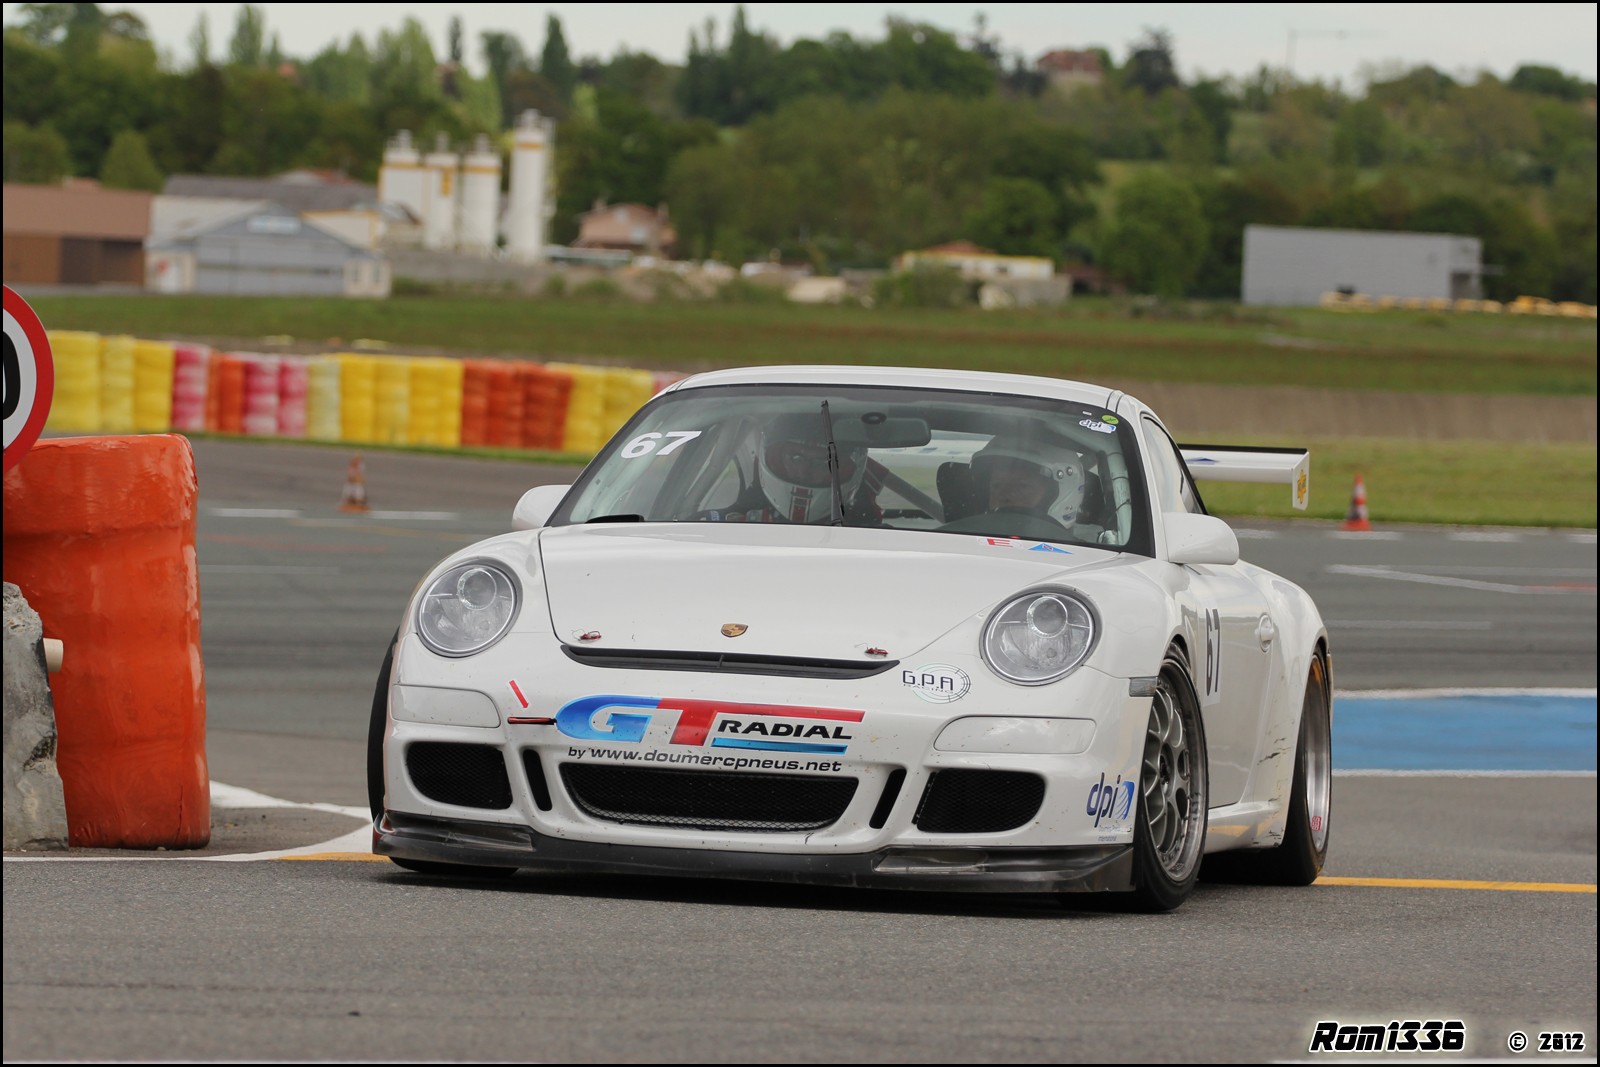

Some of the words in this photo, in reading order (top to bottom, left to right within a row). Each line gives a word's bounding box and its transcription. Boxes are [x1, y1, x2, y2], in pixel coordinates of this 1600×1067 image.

[621, 430, 703, 459] 67
[1205, 607, 1221, 697] 67
[554, 694, 867, 746] GT
[717, 719, 853, 740] RADIAL
[568, 746, 586, 760] by
[589, 748, 842, 772] www.doumercpneus.net
[1086, 772, 1121, 828] dpi
